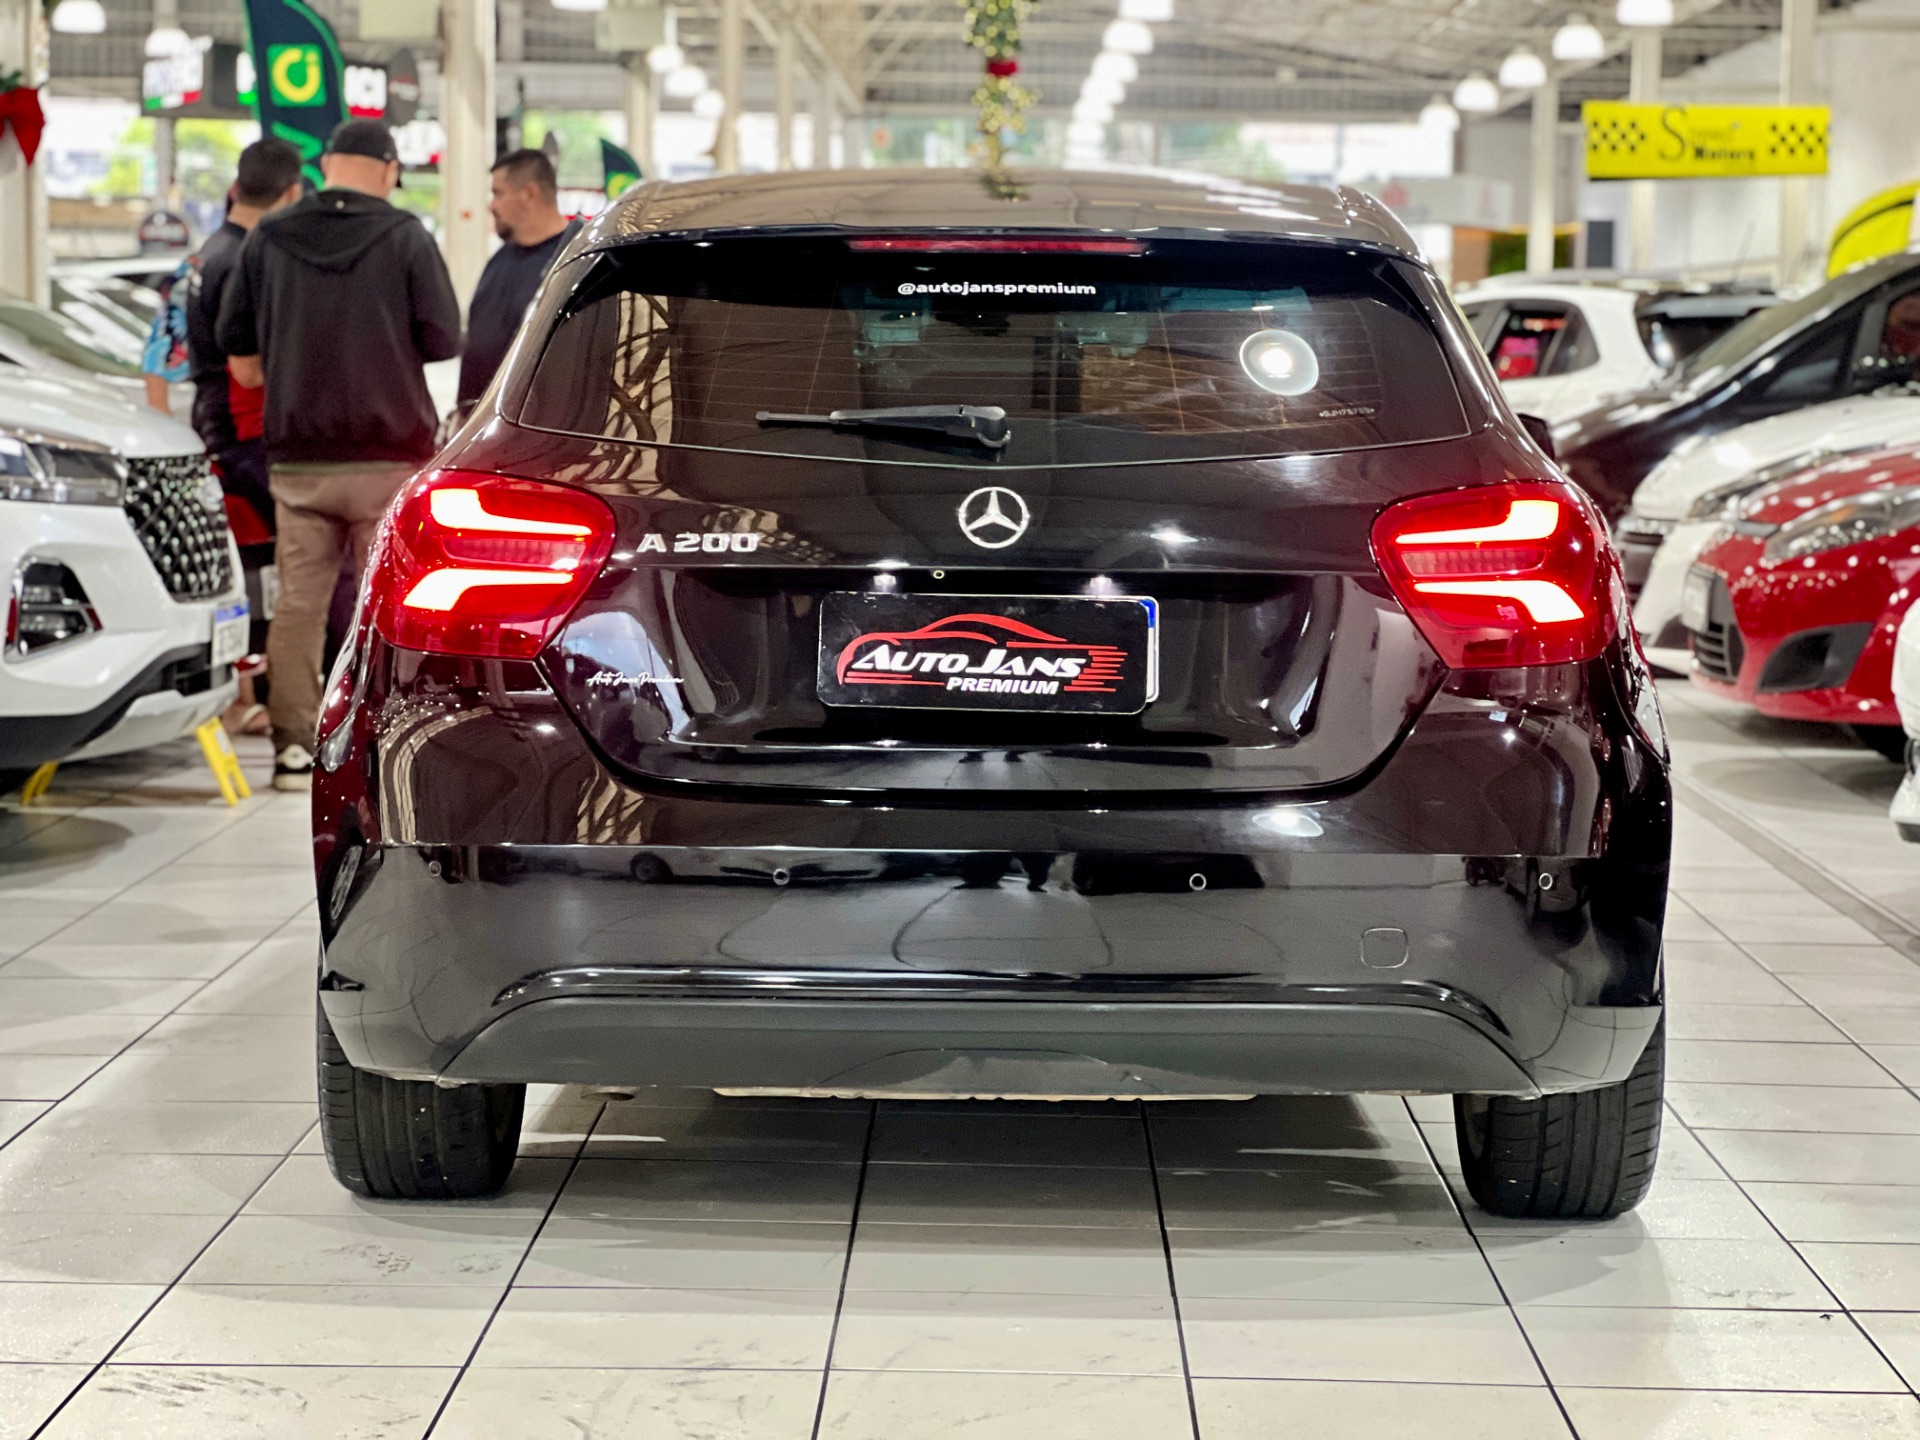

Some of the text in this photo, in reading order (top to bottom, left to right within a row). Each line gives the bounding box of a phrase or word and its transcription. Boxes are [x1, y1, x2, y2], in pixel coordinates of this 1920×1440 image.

[897, 281, 1097, 296] @autojanspremium
[636, 532, 760, 553] A 200
[946, 677, 1060, 695] PREMIUM
